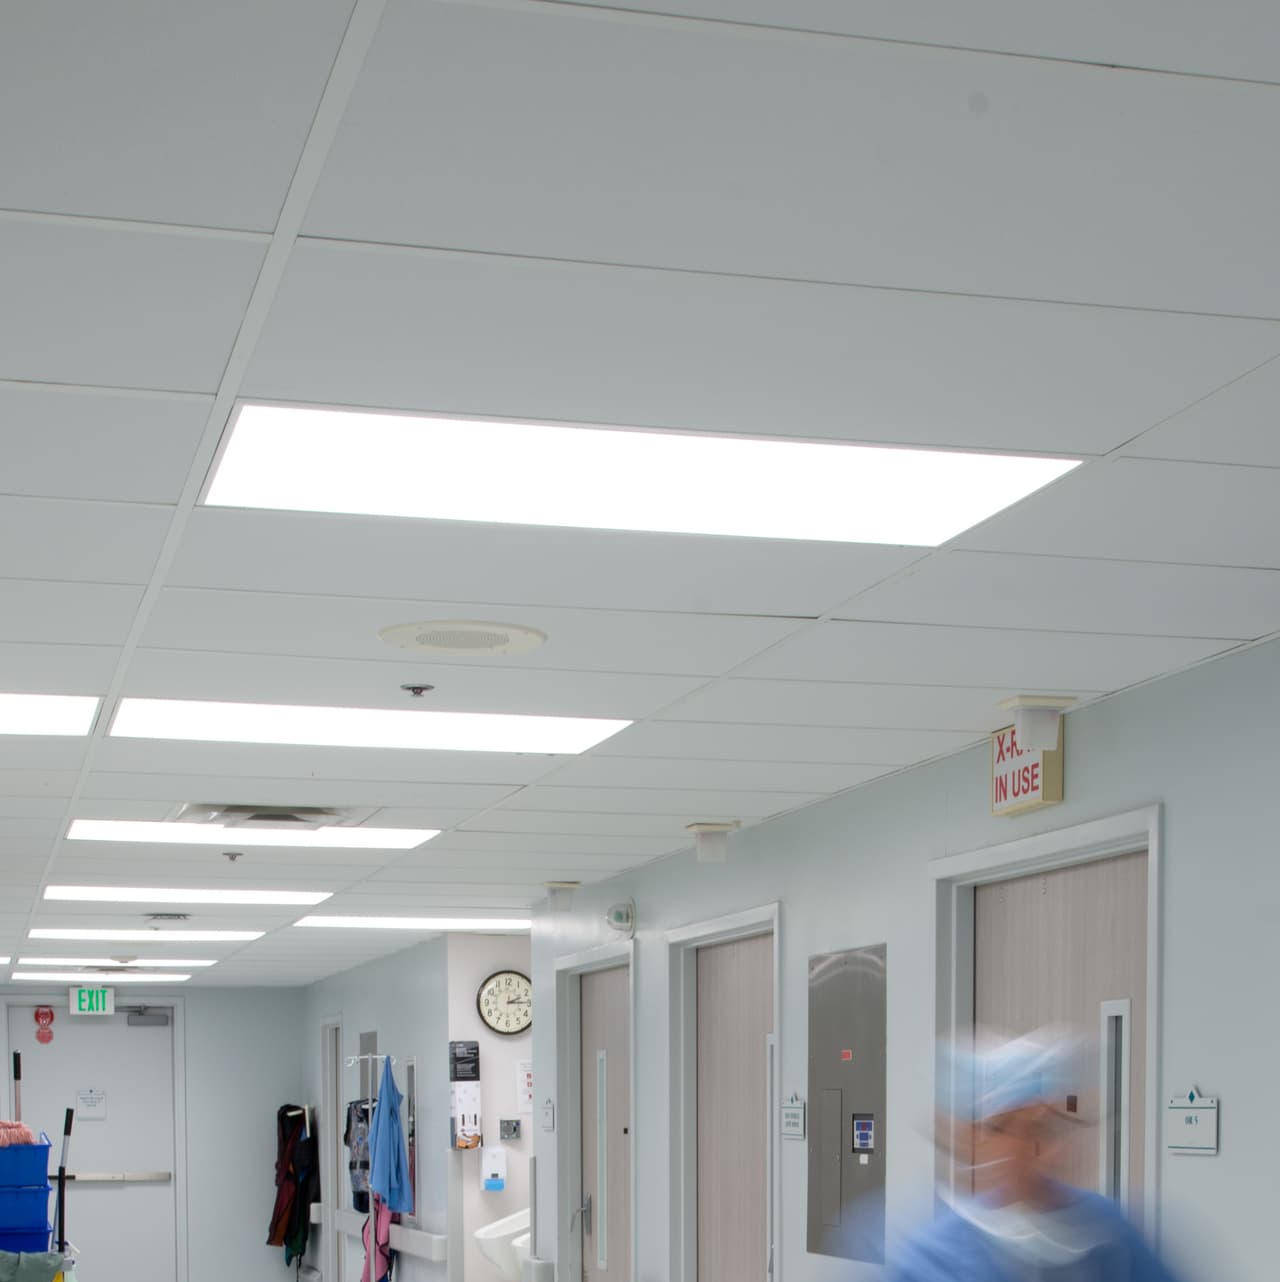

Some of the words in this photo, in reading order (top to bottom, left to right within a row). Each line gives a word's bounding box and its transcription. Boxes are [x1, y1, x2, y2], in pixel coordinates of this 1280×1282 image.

[996, 728, 1031, 764] X-R
[995, 773, 1008, 804] IN
[1012, 762, 1039, 798] USE
[78, 989, 107, 1012] EXIT
